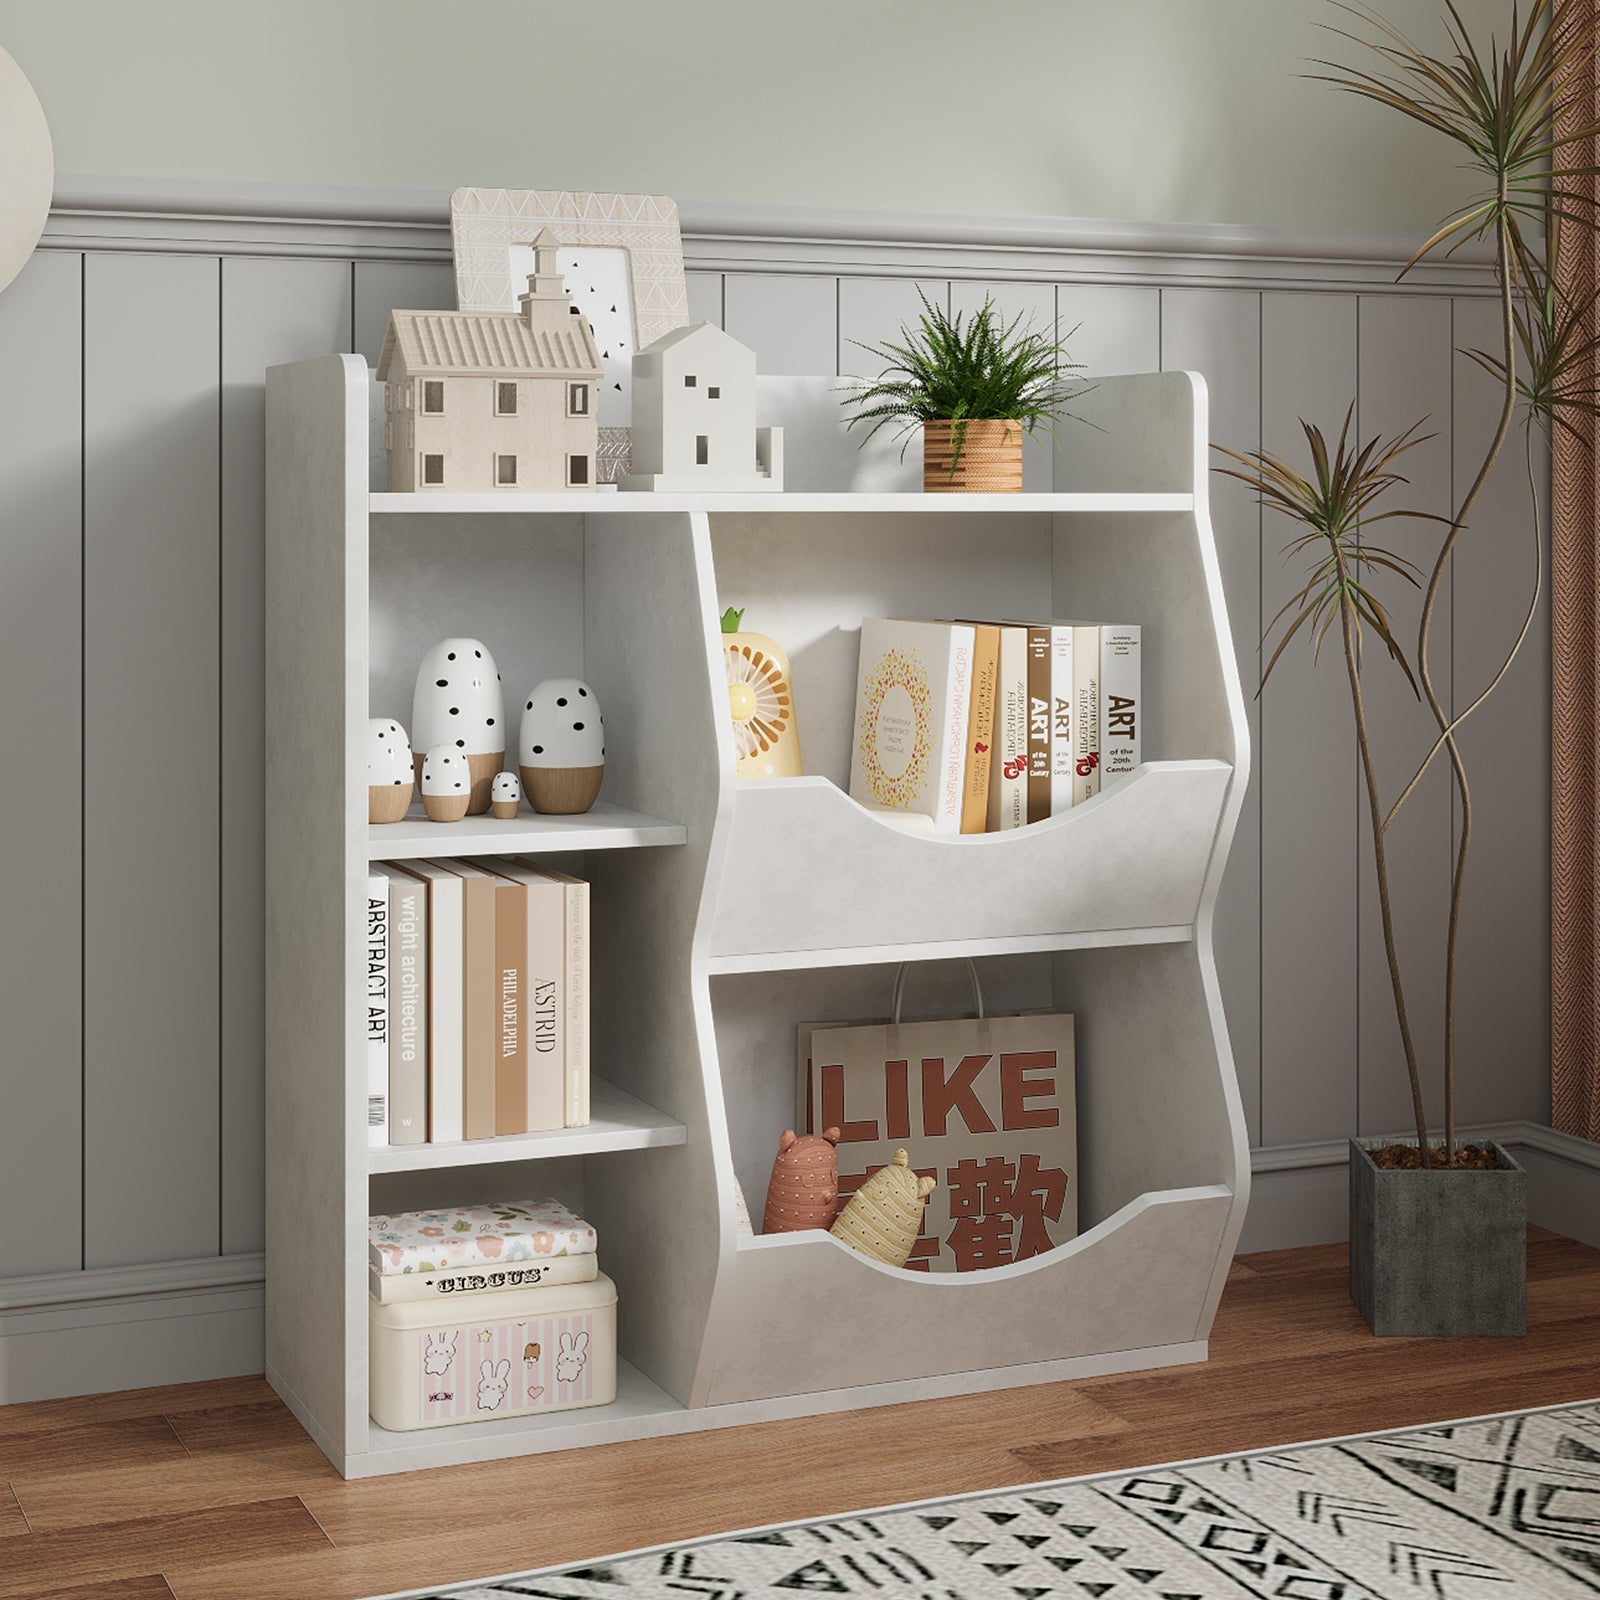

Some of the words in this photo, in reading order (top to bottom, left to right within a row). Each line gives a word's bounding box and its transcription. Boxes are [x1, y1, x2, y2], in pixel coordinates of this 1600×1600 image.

[1031, 697, 1049, 744] ART
[1055, 697, 1070, 743] ART
[1108, 695, 1136, 740] ART
[1109, 748, 1119, 756] of
[398, 896, 418, 951] wright
[368, 1007, 386, 1044] ART
[402, 956, 418, 1061] architecture
[503, 968, 517, 1058] PHILADELPHIA
[821, 1050, 1060, 1143] LIKE
[437, 1268, 542, 1293] CIRCUS
